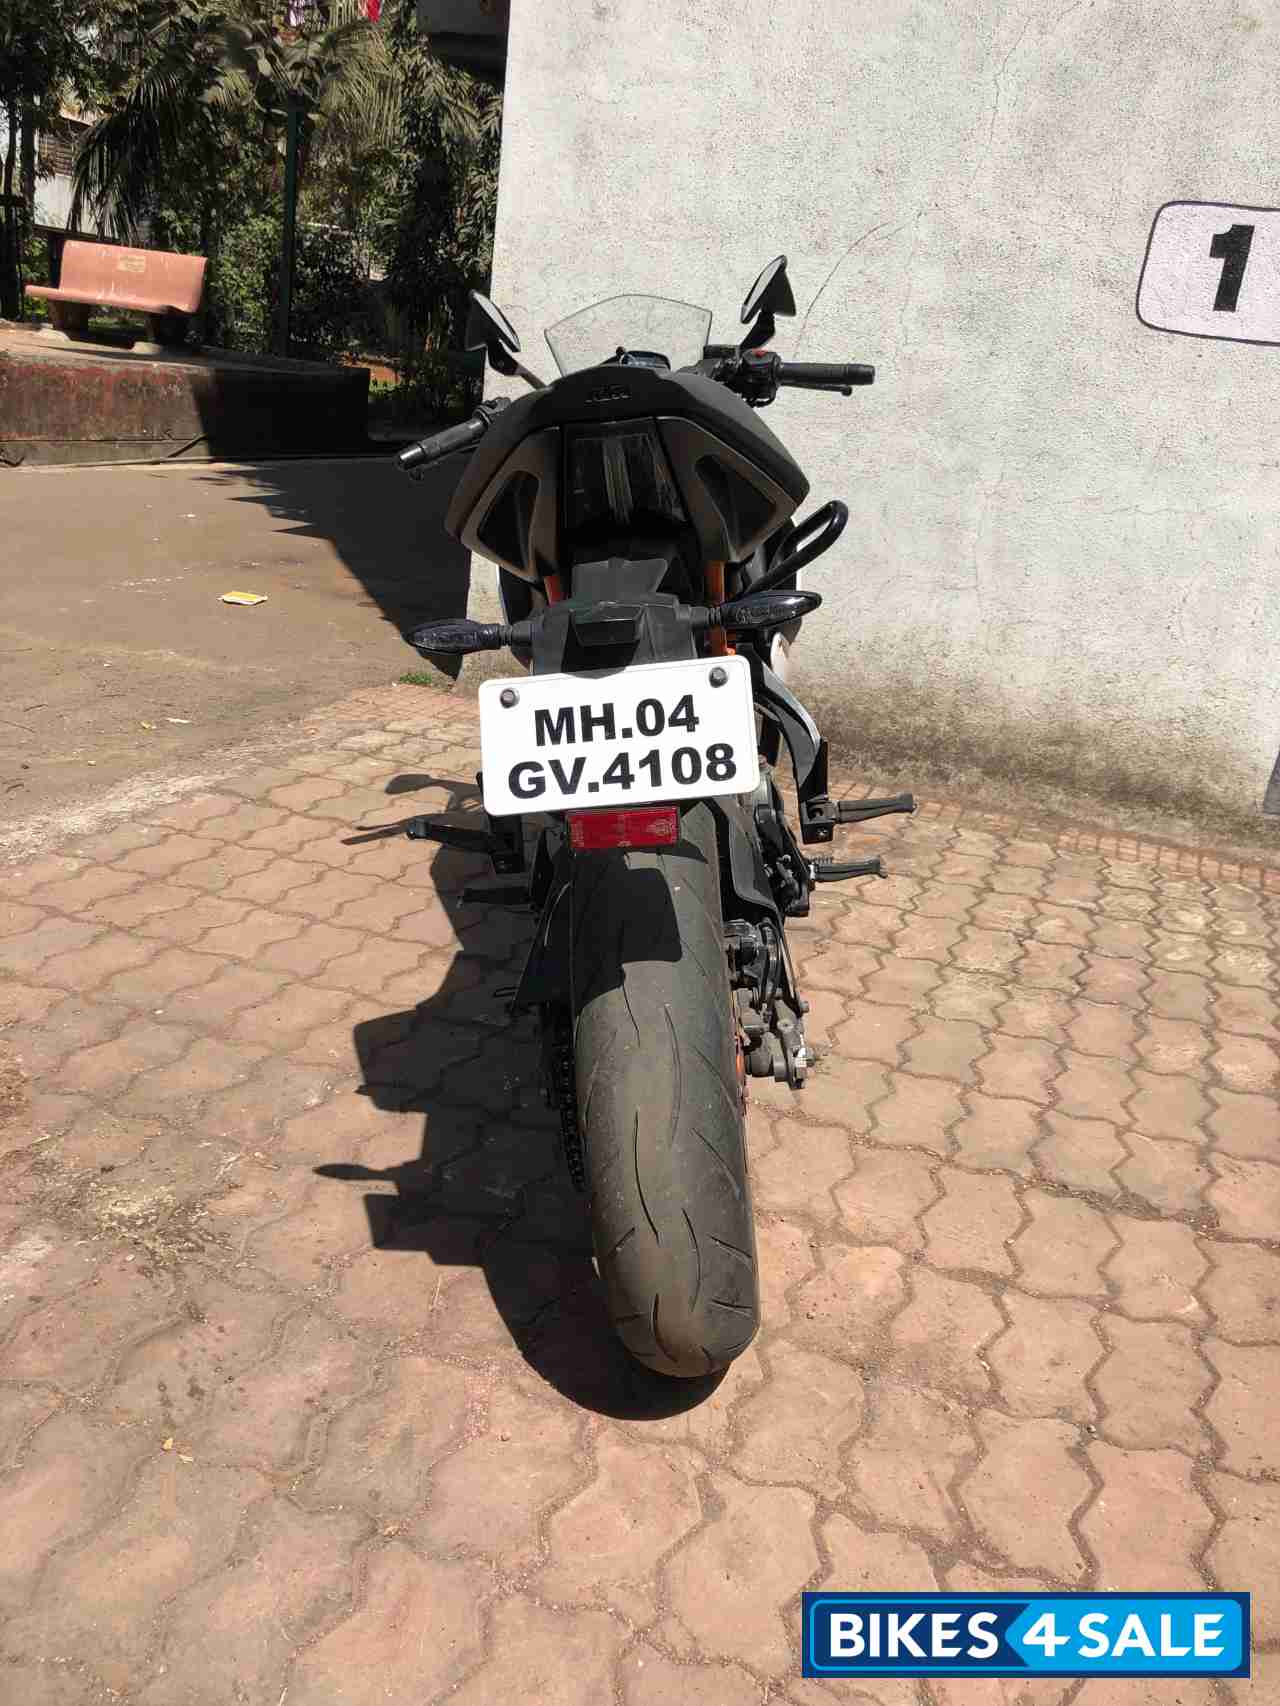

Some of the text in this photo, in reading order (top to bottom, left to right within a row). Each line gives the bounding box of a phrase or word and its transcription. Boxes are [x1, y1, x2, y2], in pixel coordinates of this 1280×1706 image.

[1209, 223, 1255, 313] 1
[534, 694, 700, 747] MH.04
[508, 743, 737, 799] GV.4108
